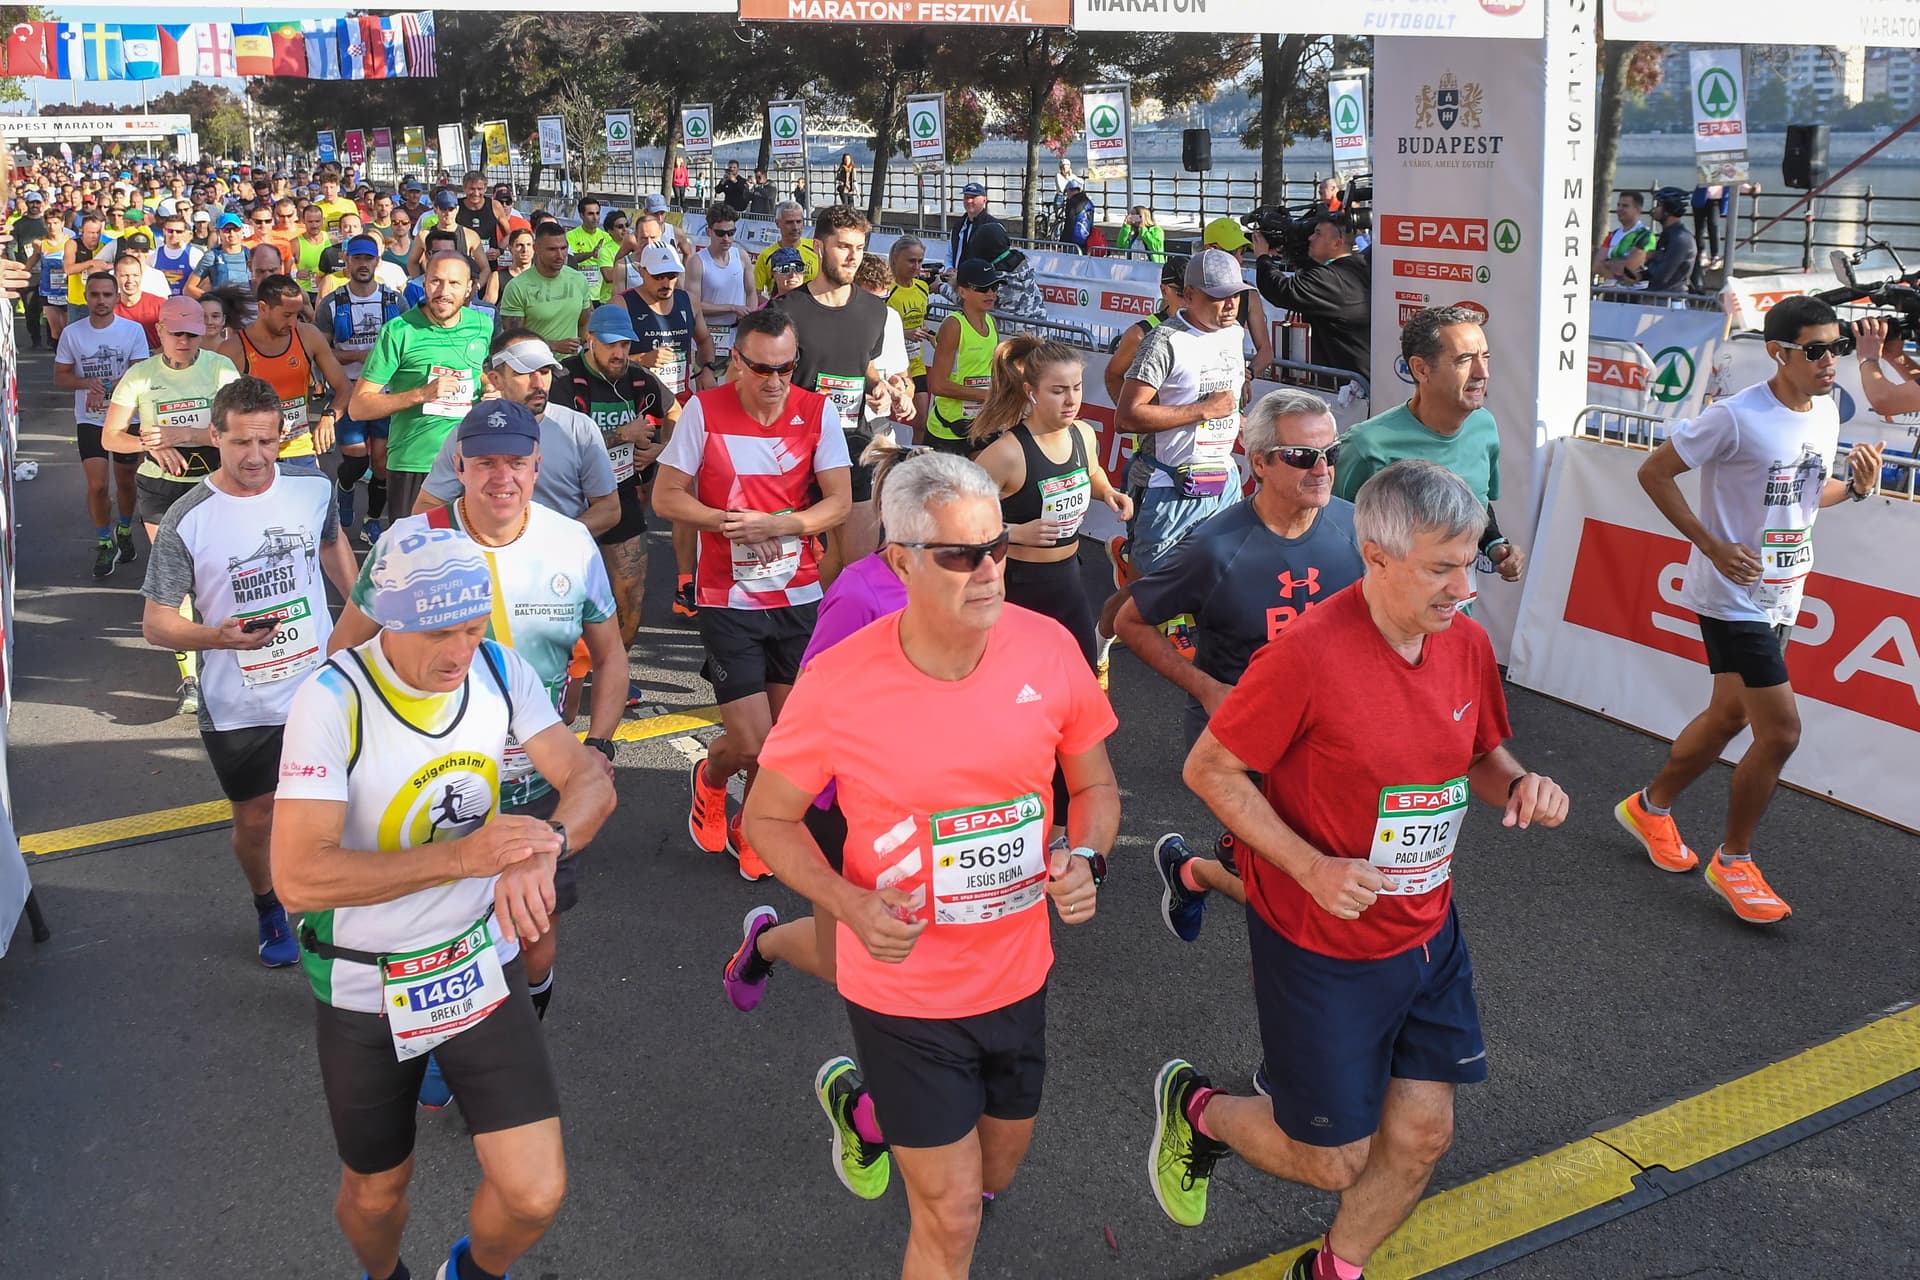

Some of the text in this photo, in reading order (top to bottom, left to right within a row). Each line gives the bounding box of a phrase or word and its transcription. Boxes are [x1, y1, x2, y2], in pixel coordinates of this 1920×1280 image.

[917, 1, 1032, 24] FESZTIVÁL
[54, 122, 113, 130] MARATON
[1699, 122, 1742, 135] SPAR
[774, 139, 800, 147] SPAR
[914, 139, 939, 149] SPAR
[1090, 139, 1123, 149] SPAR
[1336, 137, 1363, 147] SPAR
[1397, 135, 1504, 155] BUDAPEST
[1398, 221, 1486, 246] SPAR
[1404, 262, 1474, 281] DESPAR
[1559, 178, 1583, 371] MARATON
[1110, 295, 1154, 313] SPAR
[1400, 293, 1423, 301] SPAR
[659, 366, 682, 376] 2993
[166, 401, 196, 410] SPAR
[171, 414, 199, 425] 5041
[1208, 419, 1234, 431] 5902
[1055, 493, 1083, 512] 5708
[231, 565, 294, 591] BUDAPEST
[430, 579, 464, 594] SPURI
[234, 577, 297, 603] MARATON
[514, 607, 575, 616] BALTIJOS KELIAS
[412, 751, 487, 790] Szigethalmi
[1398, 792, 1449, 807] SPAR
[953, 810, 1018, 832] SPAR
[1383, 821, 1450, 846] 1 5712
[959, 836, 1025, 869] 5699
[1395, 852, 1418, 864] PACO
[966, 864, 1023, 889] JESÚS REINA
[403, 943, 468, 974] SPAR
[415, 968, 478, 1009] 1462
[430, 1006, 461, 1023] BREKI
